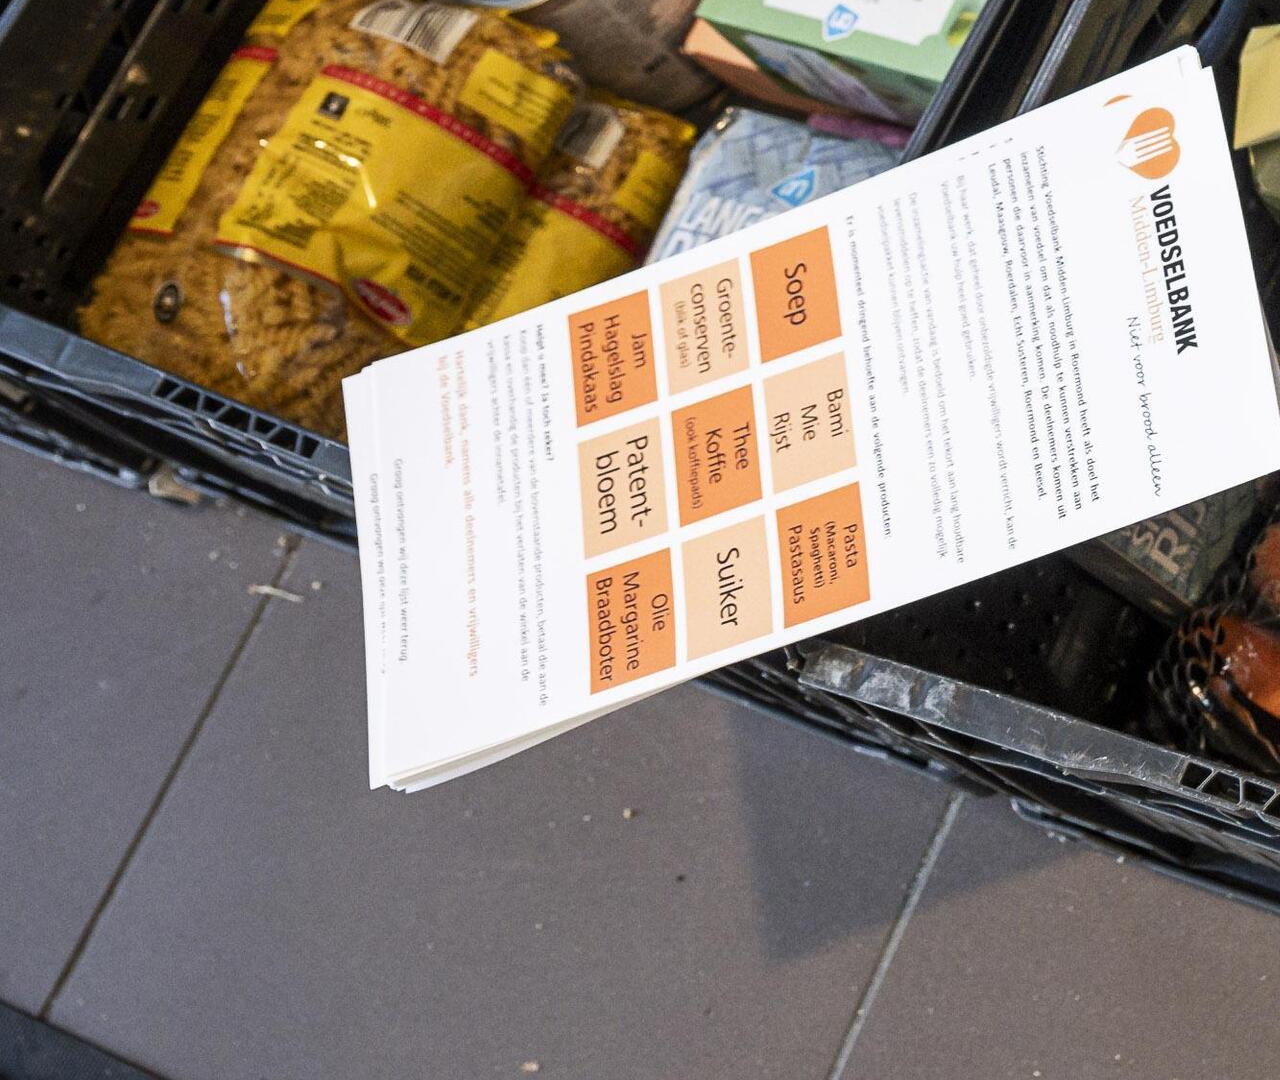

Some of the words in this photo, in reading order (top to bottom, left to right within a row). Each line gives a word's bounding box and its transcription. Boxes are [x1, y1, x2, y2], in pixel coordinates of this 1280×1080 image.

[1002, 157, 1017, 203] personen
[1020, 151, 1034, 201] inzamelen
[1035, 145, 1049, 189] Stichting
[1012, 206, 1021, 220] die
[1029, 204, 1038, 222] van
[1044, 190, 1061, 253] Voedselbank
[1015, 224, 1028, 267] daarvoor
[1033, 225, 1047, 262] voedsel
[1023, 271, 1030, 281] in
[1039, 265, 1048, 281] om
[1042, 284, 1051, 301] dat
[1128, 195, 1170, 344] Midden-Limburg
[1149, 184, 1197, 355] VOEDSELBANK
[783, 262, 806, 325] Soep
[1025, 284, 1039, 343] aanmerking
[1045, 305, 1055, 318] als
[690, 283, 710, 373] conserven
[716, 278, 736, 357] Groente-
[1126, 316, 1142, 350] Niet
[601, 314, 625, 403] Hagelslag
[631, 333, 647, 368] Jam
[1048, 321, 1062, 369] noodhulp
[1068, 340, 1075, 350] in
[576, 322, 599, 416] Pindakaas
[1040, 385, 1049, 399] De
[1056, 371, 1063, 382] te
[1071, 353, 1086, 406] Roermond
[1132, 354, 1145, 386] voor
[800, 404, 818, 440] Mie
[826, 388, 843, 437] Bami
[1023, 389, 1039, 443] Roermond
[1032, 446, 1039, 460] en
[1058, 385, 1069, 424] kunnen
[1079, 408, 1090, 436] heeft
[1138, 392, 1157, 439] brood
[682, 416, 697, 443] (ook
[732, 421, 751, 469] Thee
[769, 412, 791, 452] Rijst
[1043, 403, 1057, 463] deelnemers
[1083, 441, 1093, 455] als
[687, 443, 702, 512] koffiepads)
[705, 428, 725, 483] Koffie
[1064, 427, 1078, 487] verstrekken
[1086, 458, 1098, 480] doel
[1146, 444, 1162, 496] alleen
[595, 450, 620, 534] bloem
[626, 435, 651, 527] Patent-
[1052, 464, 1062, 501] komen
[1073, 491, 1081, 510] aan
[1090, 483, 1099, 502] het
[1057, 504, 1066, 519] uit
[787, 524, 804, 604] Pastasaus
[808, 527, 825, 588] Spaghetti)
[824, 520, 837, 584] (Macaroni,
[843, 523, 858, 568] Pasta
[716, 547, 743, 625] Suiker
[591, 577, 616, 680] Braadboter
[620, 571, 643, 670] Margarine
[651, 593, 669, 631] Olie
